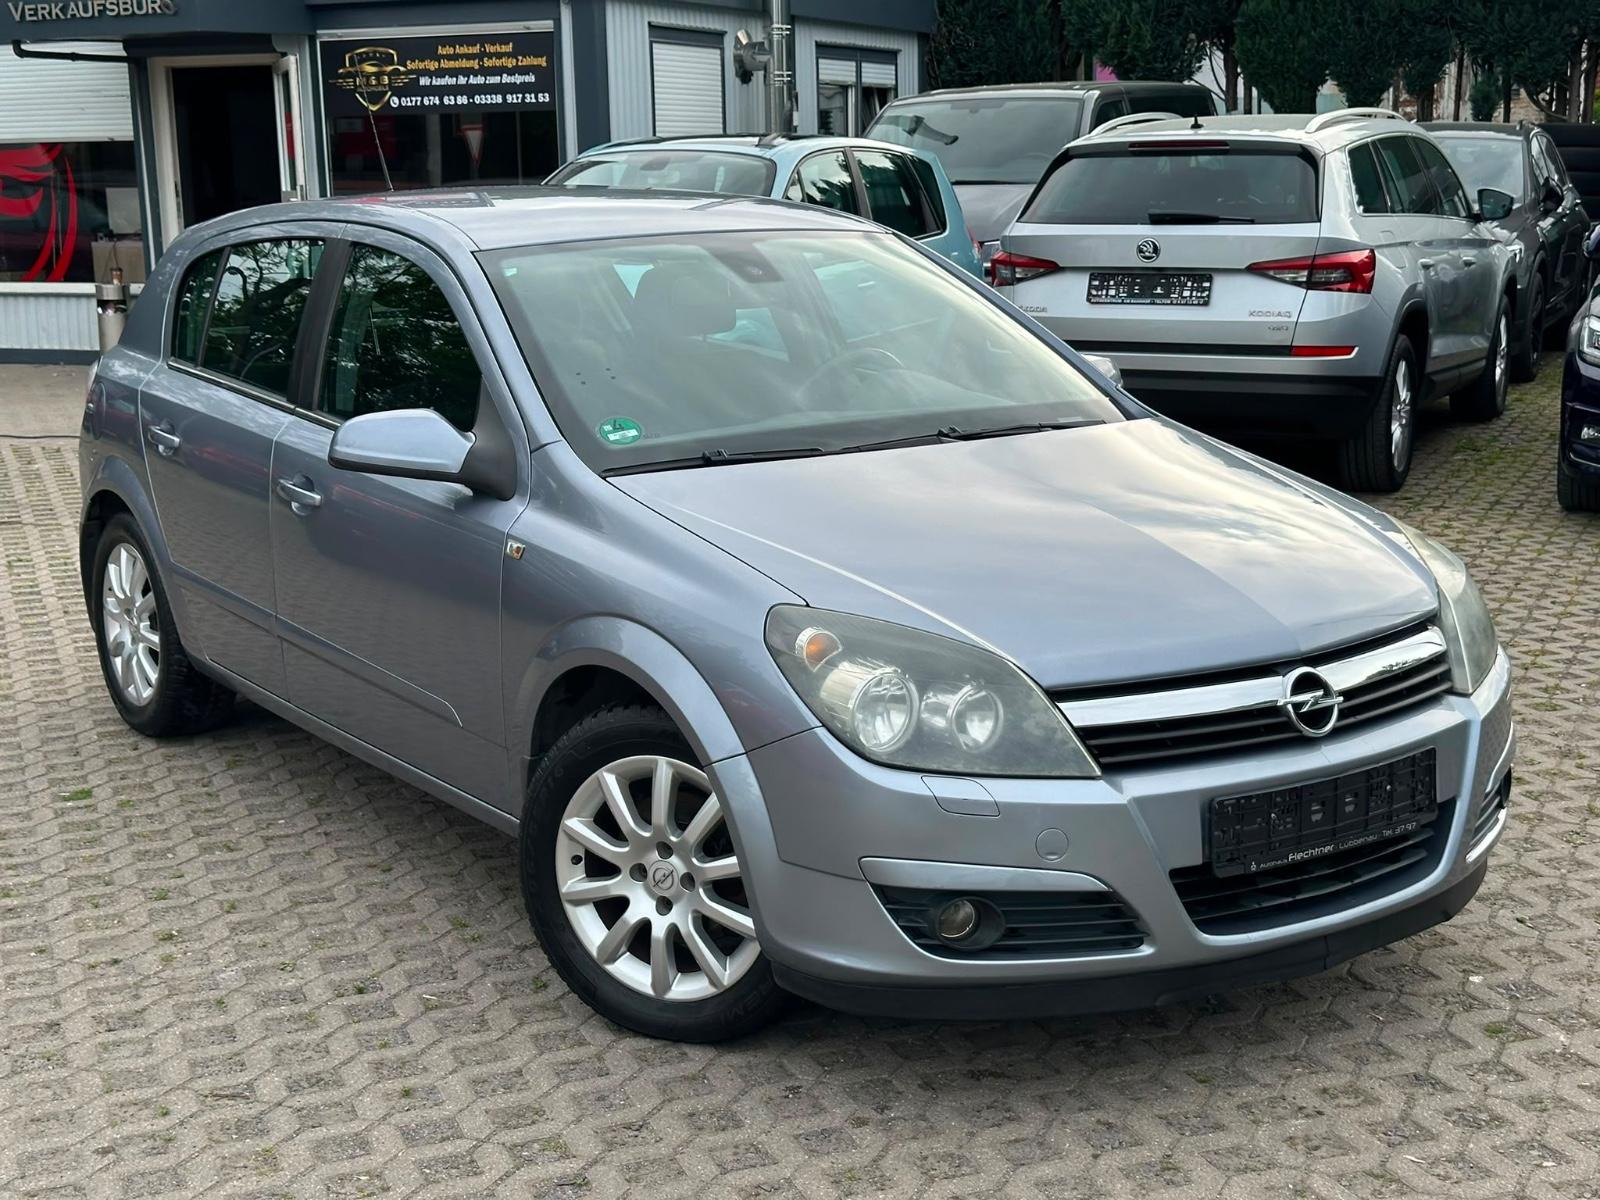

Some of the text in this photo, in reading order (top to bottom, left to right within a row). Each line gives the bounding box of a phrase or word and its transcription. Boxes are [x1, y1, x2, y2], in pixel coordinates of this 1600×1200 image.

[437, 45, 454, 55] Auto
[455, 44, 480, 55] Ankauf
[485, 42, 513, 53] Verkauf
[406, 59, 439, 70] Sofortige
[440, 58, 479, 69] Abmeldung
[483, 57, 517, 68] Sofortige
[517, 55, 547, 66] Zahlung
[419, 76, 431, 86] Wir
[432, 75, 457, 85] kaufen
[468, 74, 485, 84] Auto
[485, 75, 501, 84] zum
[501, 72, 536, 84] Bestpreis
[400, 96, 422, 106] 0177
[423, 96, 440, 105] 674
[443, 96, 455, 105] 63
[474, 94, 502, 104] 03338
[506, 94, 523, 103] 917
[524, 93, 536, 102] 31
[537, 93, 549, 102] 53
